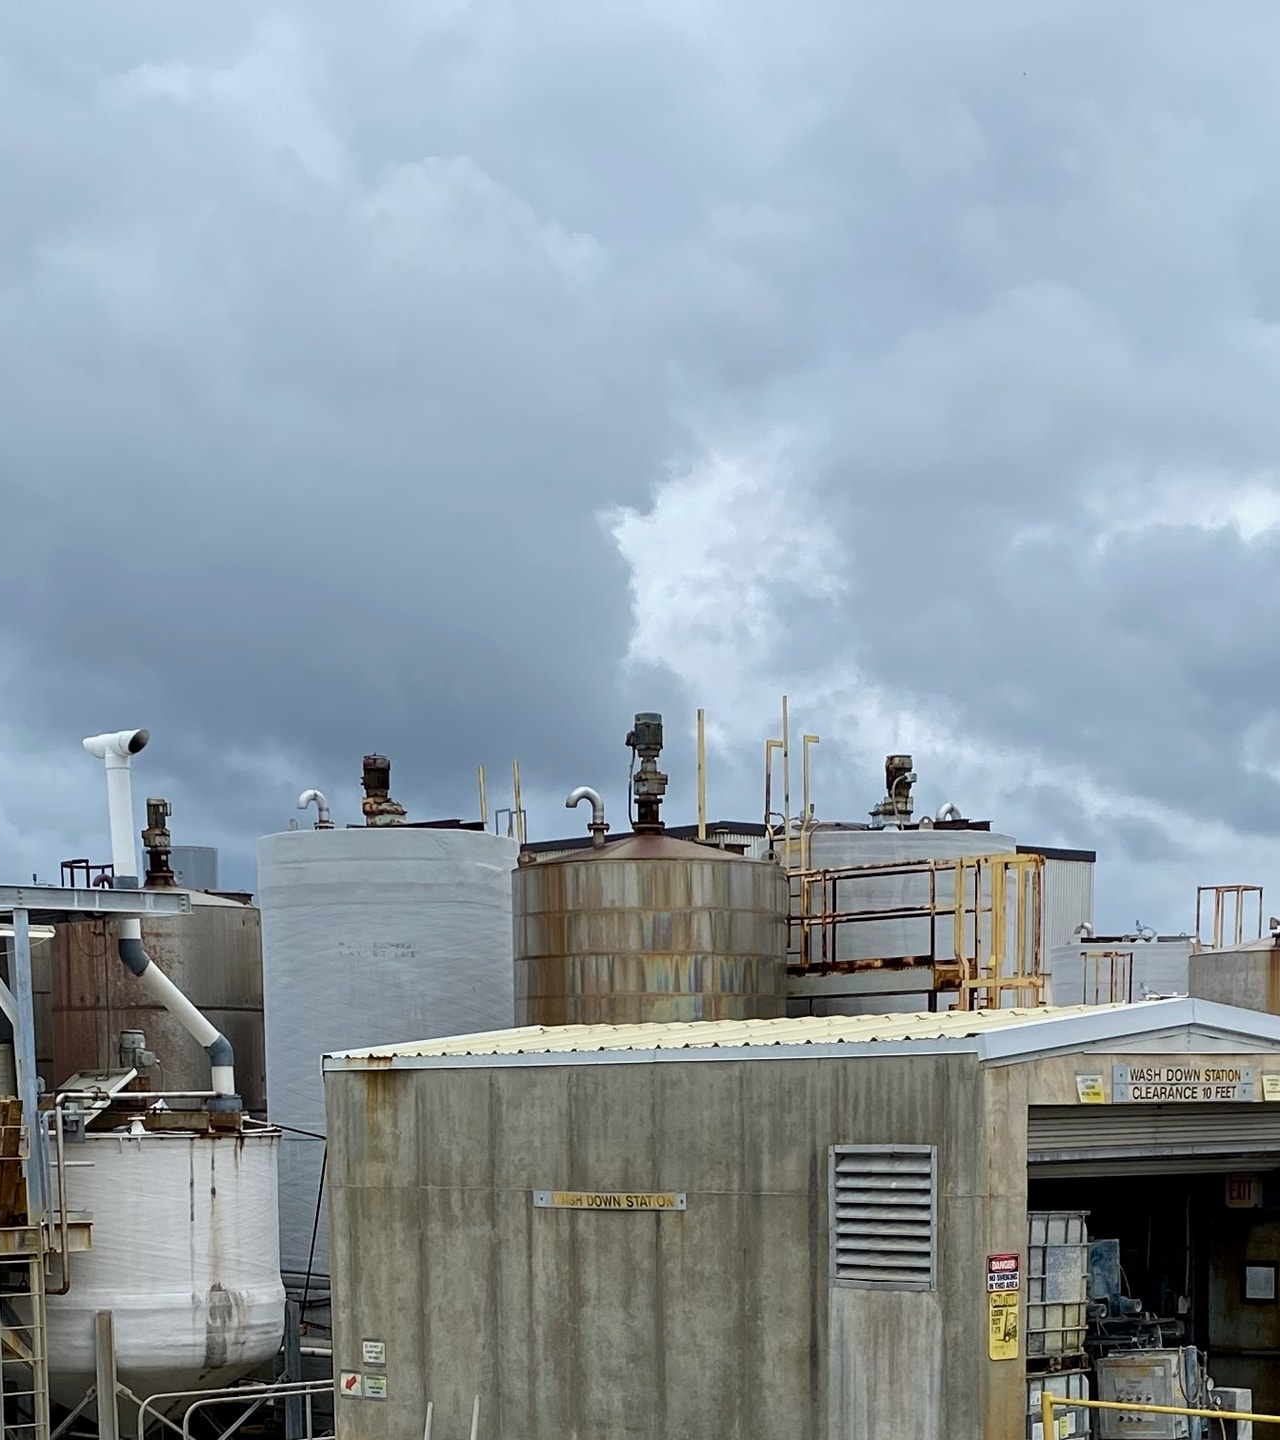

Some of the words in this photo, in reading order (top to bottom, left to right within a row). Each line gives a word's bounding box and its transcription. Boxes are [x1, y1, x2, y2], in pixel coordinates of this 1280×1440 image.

[1129, 1068, 1161, 1082] WASH
[1166, 1068, 1200, 1081] DOWN
[1204, 1068, 1241, 1082] STATION
[1132, 1086, 1198, 1099] CLEARANCE
[1202, 1086, 1212, 1099] 10
[1215, 1086, 1237, 1099] FEET
[1229, 1179, 1253, 1201] EXIT
[586, 1195, 621, 1207] DOWN
[626, 1195, 674, 1208] STATON
